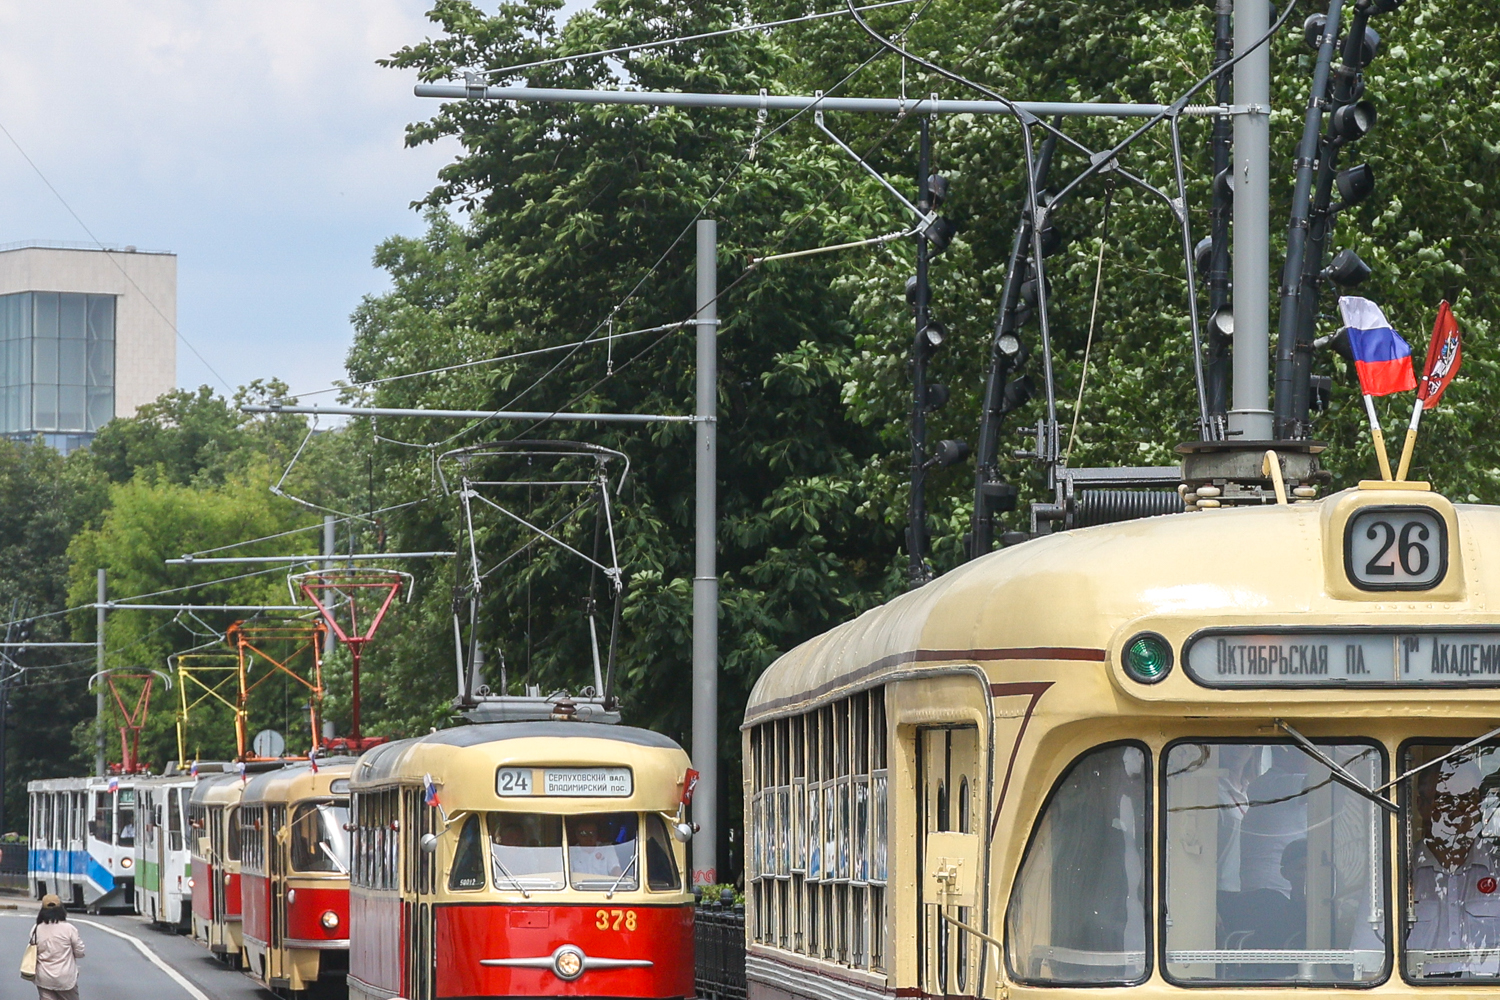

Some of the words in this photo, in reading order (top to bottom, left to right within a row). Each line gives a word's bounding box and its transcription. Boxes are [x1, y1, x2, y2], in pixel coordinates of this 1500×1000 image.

[1365, 521, 1430, 576] 26
[1216, 638, 1329, 676] ОКТЯБРЬСКАЯ
[1345, 644, 1371, 675] ПЛ.
[501, 771, 528, 791] 24
[548, 773, 606, 782] СЕРПУХОВСКИЙ
[548, 783, 608, 792] ВЛАДИМИРСКИЙ
[595, 909, 638, 932] 378
